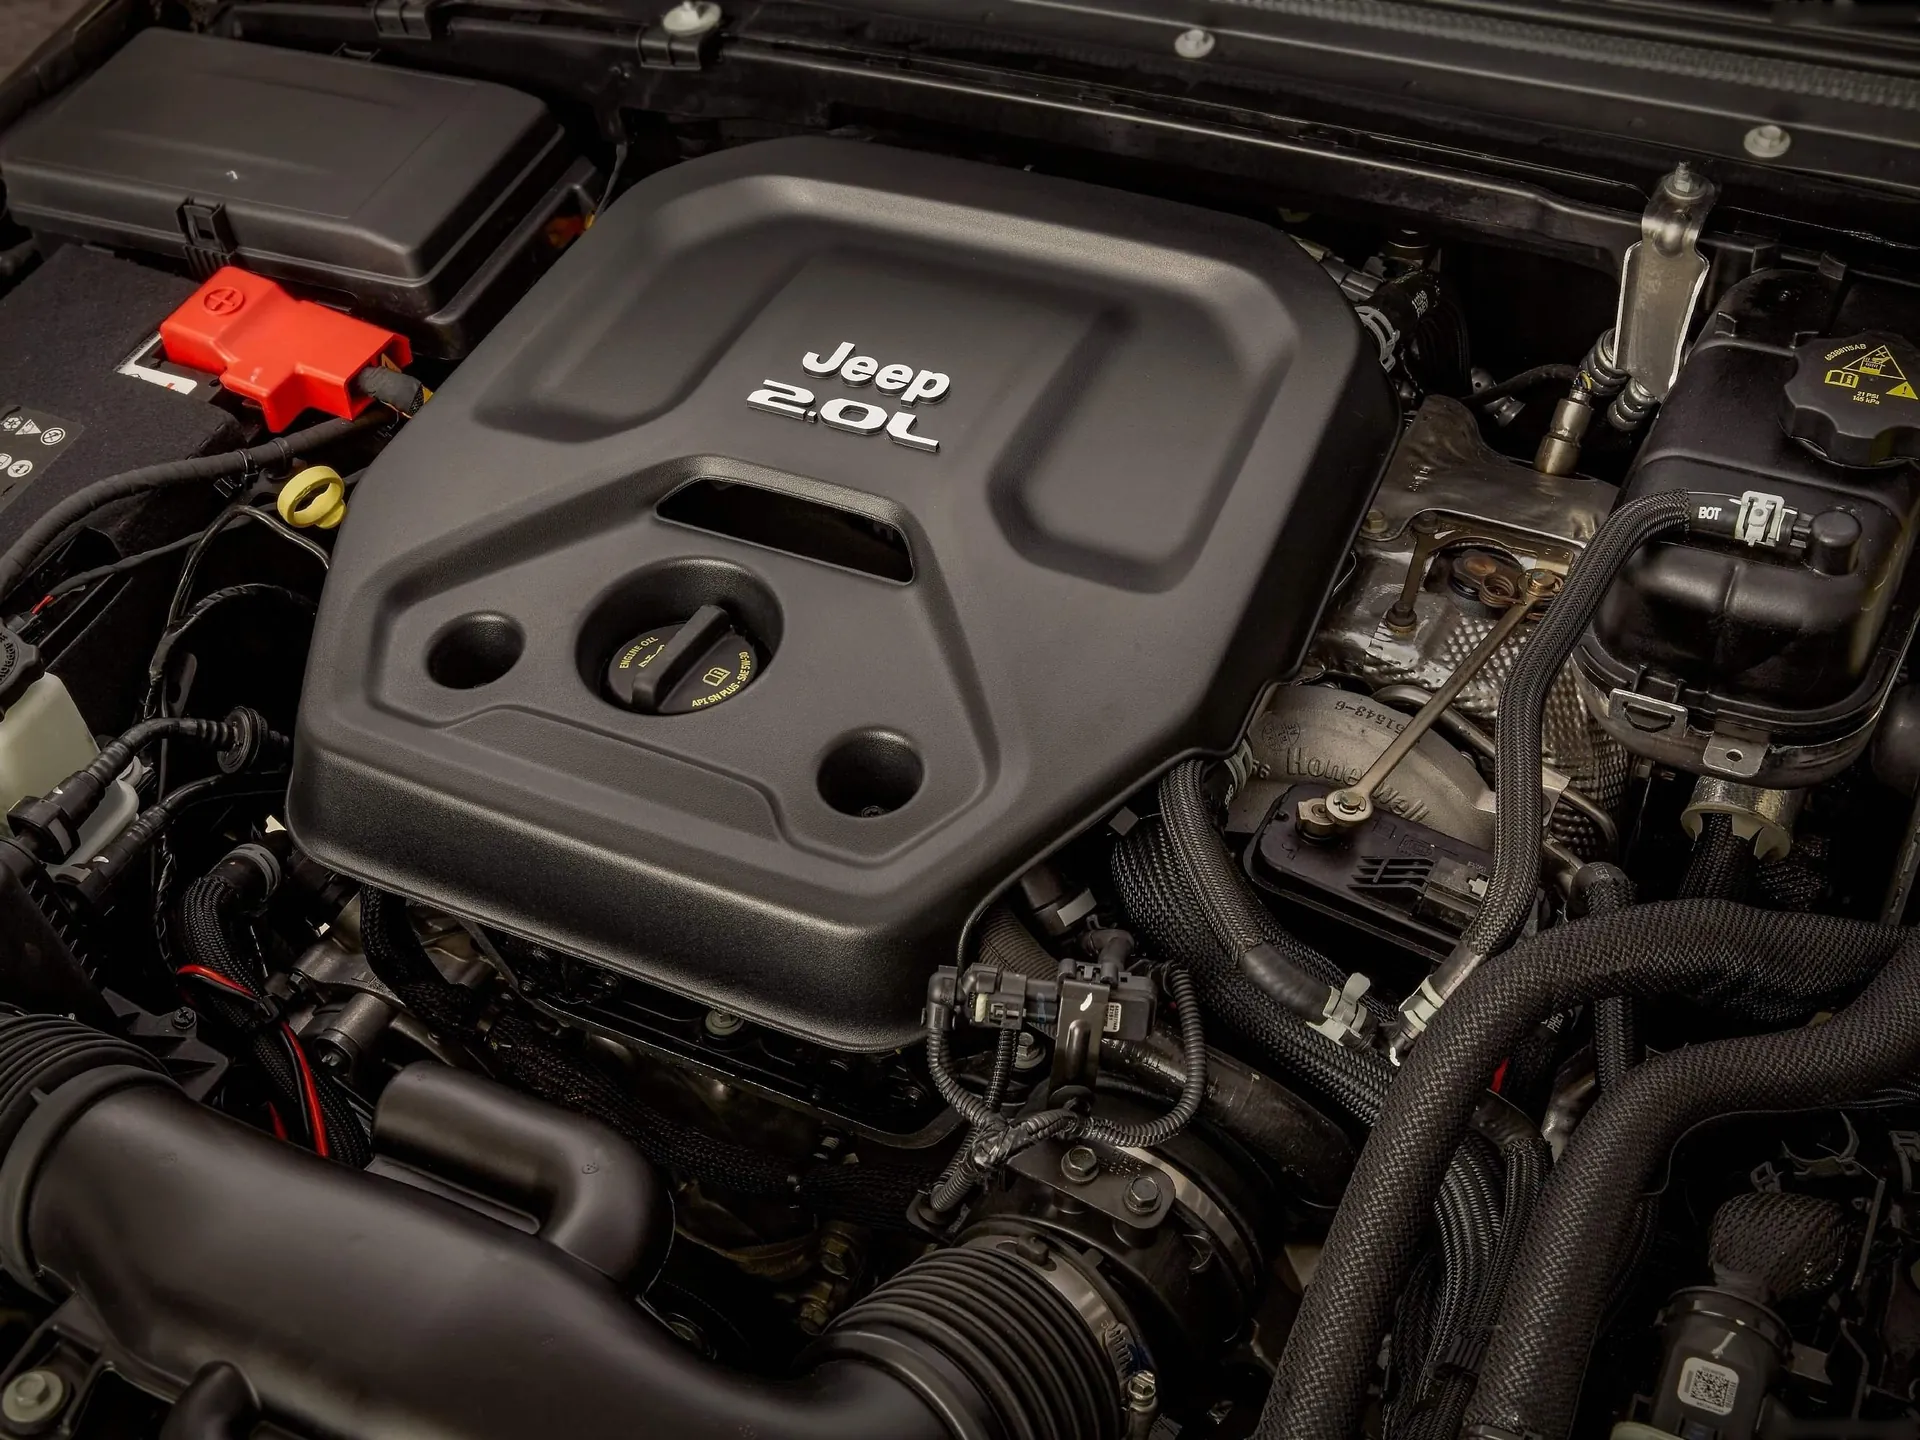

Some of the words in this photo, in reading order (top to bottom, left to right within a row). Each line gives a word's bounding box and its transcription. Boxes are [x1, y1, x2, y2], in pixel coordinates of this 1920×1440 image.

[802, 341, 951, 407] Jeep
[747, 379, 939, 453] 2.0L
[1865, 397, 1880, 405] kPa
[1698, 506, 1722, 520] BOT
[619, 645, 643, 669] ENGINE
[640, 636, 659, 647] OIL
[692, 698, 709, 707] API
[708, 692, 722, 703] SN
[719, 682, 740, 697] PLUS
[736, 669, 750, 682] SAE
[1286, 746, 1431, 823] Honewell
